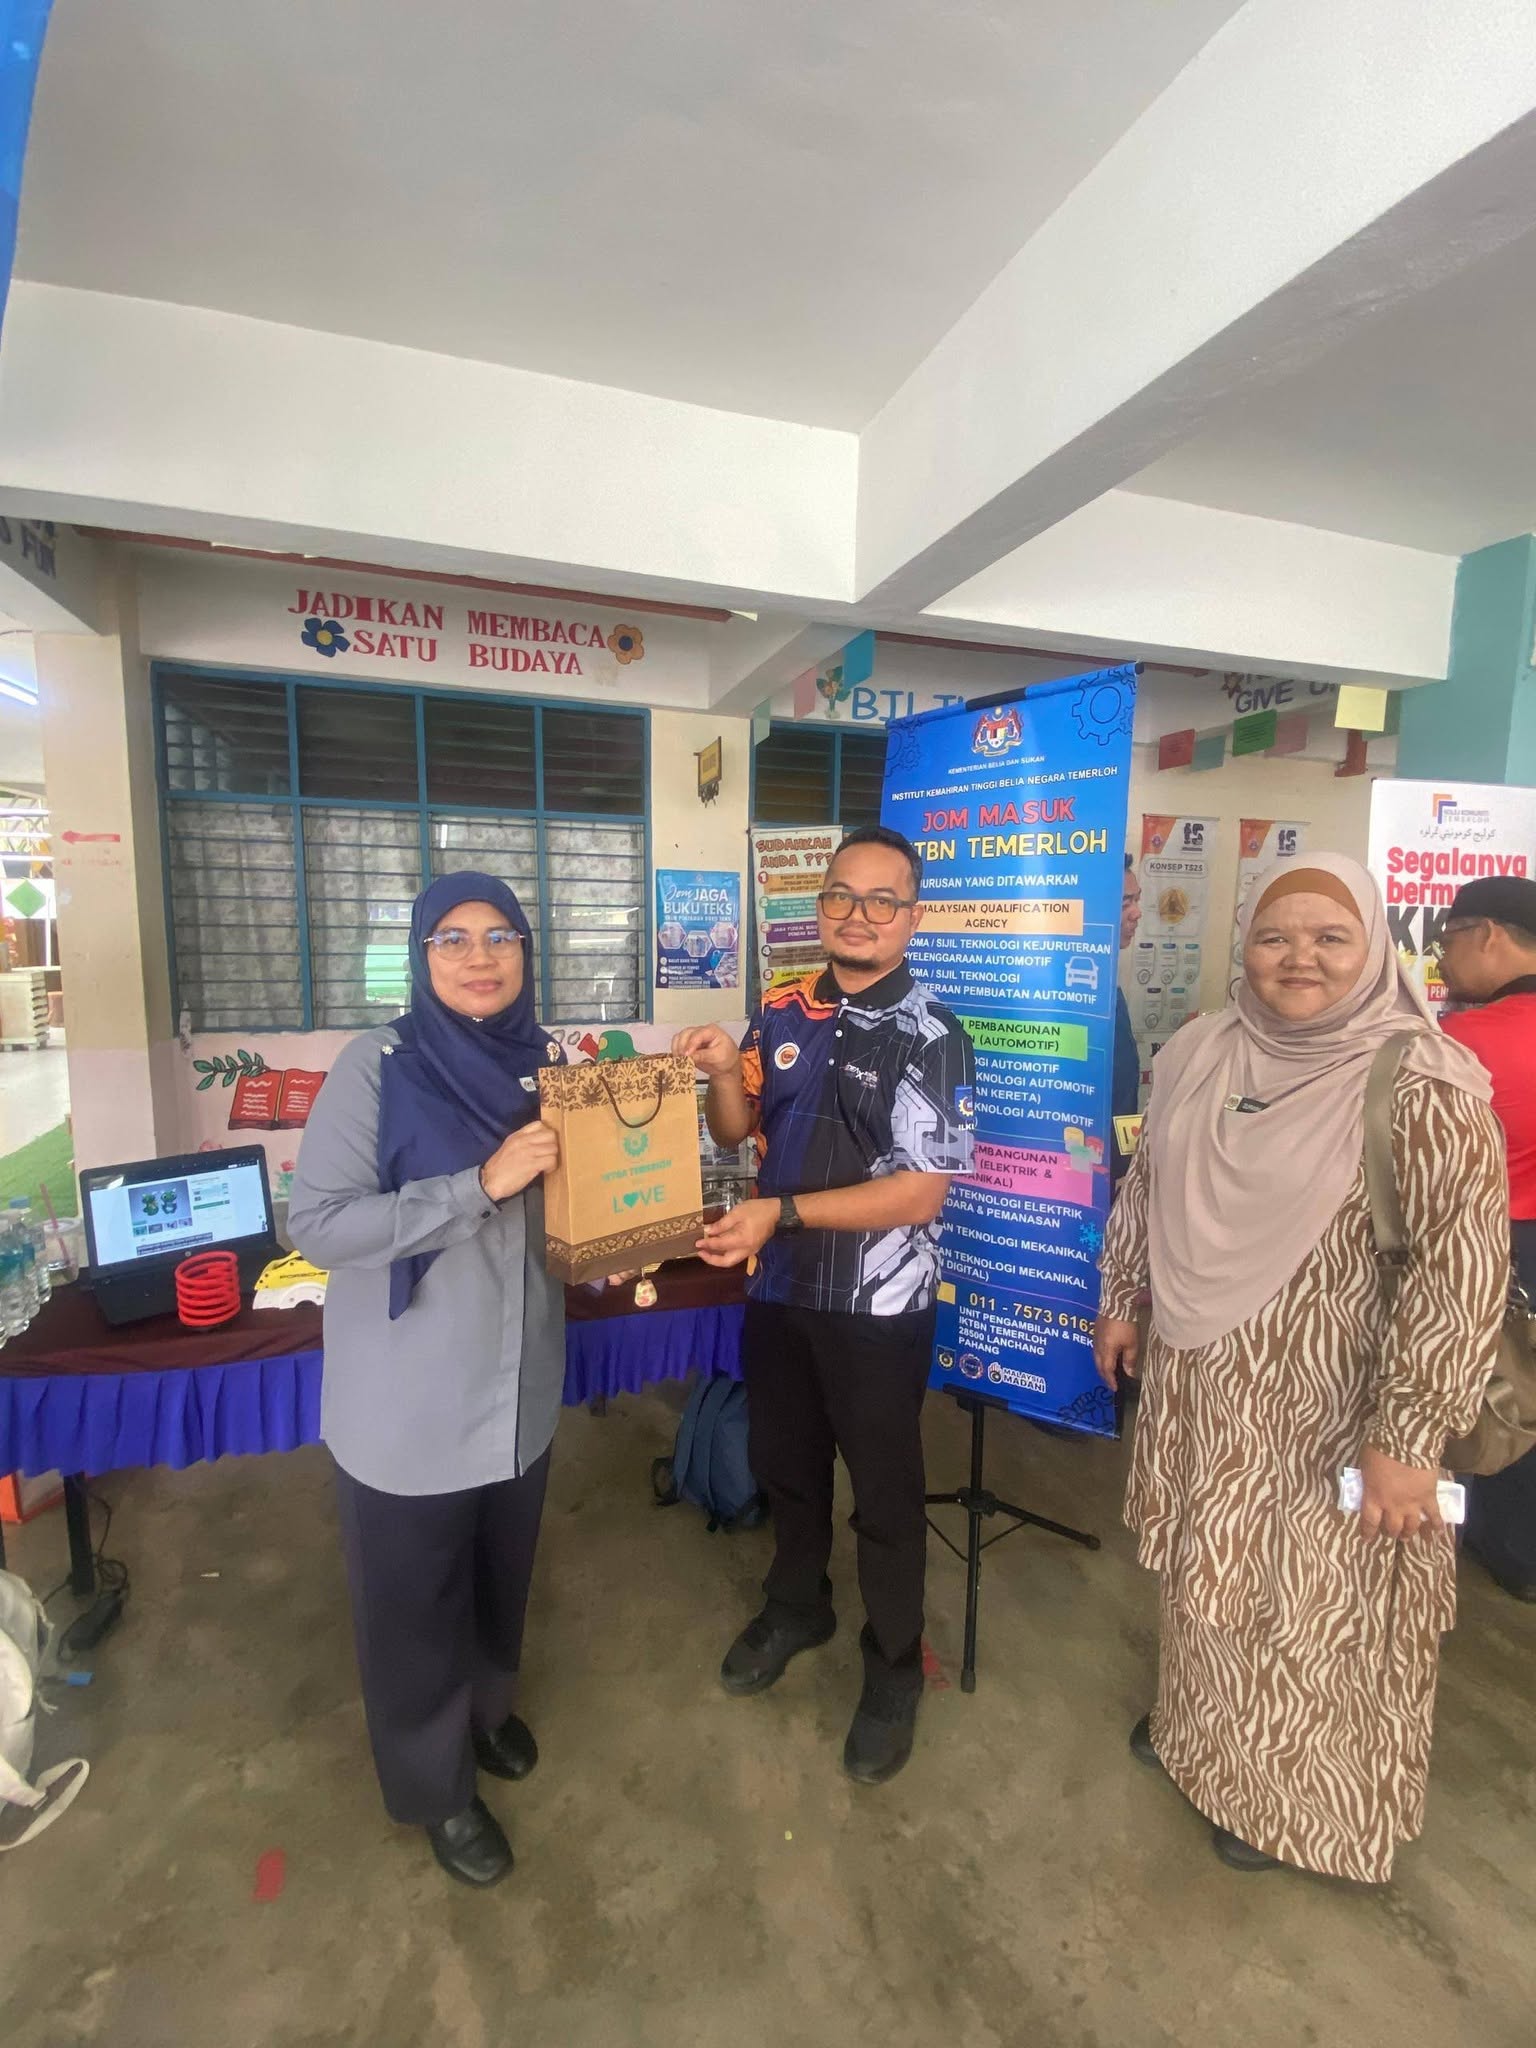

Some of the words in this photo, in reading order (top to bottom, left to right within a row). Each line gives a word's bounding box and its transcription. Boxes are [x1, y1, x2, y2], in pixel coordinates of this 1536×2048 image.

[288, 589, 444, 630] JADIKAN
[467, 610, 607, 649] MEMBACA
[353, 630, 438, 662] SATU
[468, 643, 584, 675] BUDAYA
[1309, 681, 1338, 695] U
[948, 763, 987, 775] KEMENTERIAN
[988, 760, 1005, 769] BELIA
[1006, 759, 1020, 767] DAN
[1021, 756, 1045, 764] SUKAN
[891, 789, 925, 801] INSTITUT
[926, 784, 969, 798] KEMAHIRAN
[971, 781, 998, 792] TINGGI
[999, 777, 1025, 788] BELIA
[1027, 773, 1066, 785] NEGARA
[1067, 766, 1118, 780] TEMERLOH
[921, 806, 969, 833] JOM
[978, 797, 1076, 828] MASUK
[755, 837, 832, 852] SUDAHKAH
[910, 840, 956, 862] TBN
[967, 829, 1108, 859] TEMERLOH
[760, 854, 799, 868] ANDA
[1150, 862, 1183, 870] KONSEP
[964, 875, 995, 888] YANG
[997, 874, 1078, 887] DITAWARKAN
[1386, 875, 1461, 906] berm
[693, 889, 728, 901] JAGA
[663, 902, 700, 914] BUKU
[704, 903, 733, 915] TEKS
[980, 903, 1070, 914] QUALIFICATION
[965, 919, 1008, 928] AGENCY
[1386, 905, 1448, 956] KK
[908, 938, 929, 947] OMA
[936, 938, 957, 948] SIJIL
[960, 939, 1020, 950] TEKNOLOGI
[1023, 940, 1111, 955] KEJURUTERAAN
[985, 955, 1052, 967] AUTOMOTIF
[909, 968, 929, 978] OMA
[936, 969, 957, 980] SIJIL
[960, 970, 1020, 983] TEKNOLOGI
[922, 982, 961, 994] TERAAN
[963, 984, 1030, 999] PEMBUATAN
[1033, 989, 1097, 1004] AUTOMOTIF
[968, 1020, 1060, 1036] PEMBANGUNAN
[979, 1034, 1059, 1052] (AUTOMOTIF)
[974, 1057, 989, 1067] OGI
[991, 1059, 1060, 1074] AUTOMOTIF
[975, 1072, 1026, 1087] KNOLOGI
[1029, 1078, 1096, 1096] AUTOMOTIF
[975, 1087, 988, 1097] AN
[990, 1087, 1041, 1105] KERETA)
[974, 1102, 1024, 1118] KNOLOGI
[1027, 1109, 1094, 1127] AUTOMOTIF
[974, 1145, 1058, 1165] EMBANGUNAN
[980, 1158, 1037, 1178] (ELEKTRIK
[1044, 1170, 1053, 1179] &
[962, 1173, 1013, 1188] ANIKAL)
[958, 1187, 1021, 1209] TEKNOLOGI
[1024, 1201, 1083, 1220] ELEKTRIK
[976, 1206, 985, 1215] &
[986, 1207, 1061, 1228] PEMANASAN
[956, 1225, 1018, 1248] TEKNOLOGI
[1020, 1240, 1090, 1263] MEKANIKAL
[946, 1261, 990, 1282] DIGITAL)
[954, 1250, 1016, 1274] TEKNOLOGI
[1018, 1266, 1088, 1290] MEKANIKAL
[969, 1292, 996, 1311] 011
[1013, 1302, 1053, 1324] 7573
[958, 1316, 987, 1332] IKTBN
[989, 1323, 1047, 1346] TEMERLOH
[959, 1306, 981, 1319] UNIT
[983, 1312, 1059, 1338] PENGAMBILAN
[1062, 1331, 1070, 1340] &
[1072, 1333, 1094, 1349] REK
[958, 1326, 984, 1342] 28500
[986, 1333, 1045, 1356] LANCHANG
[958, 1336, 1000, 1355] PAHANG
[1003, 1368, 1045, 1385] MALAYSIA
[1003, 1375, 1046, 1393] MADANI
